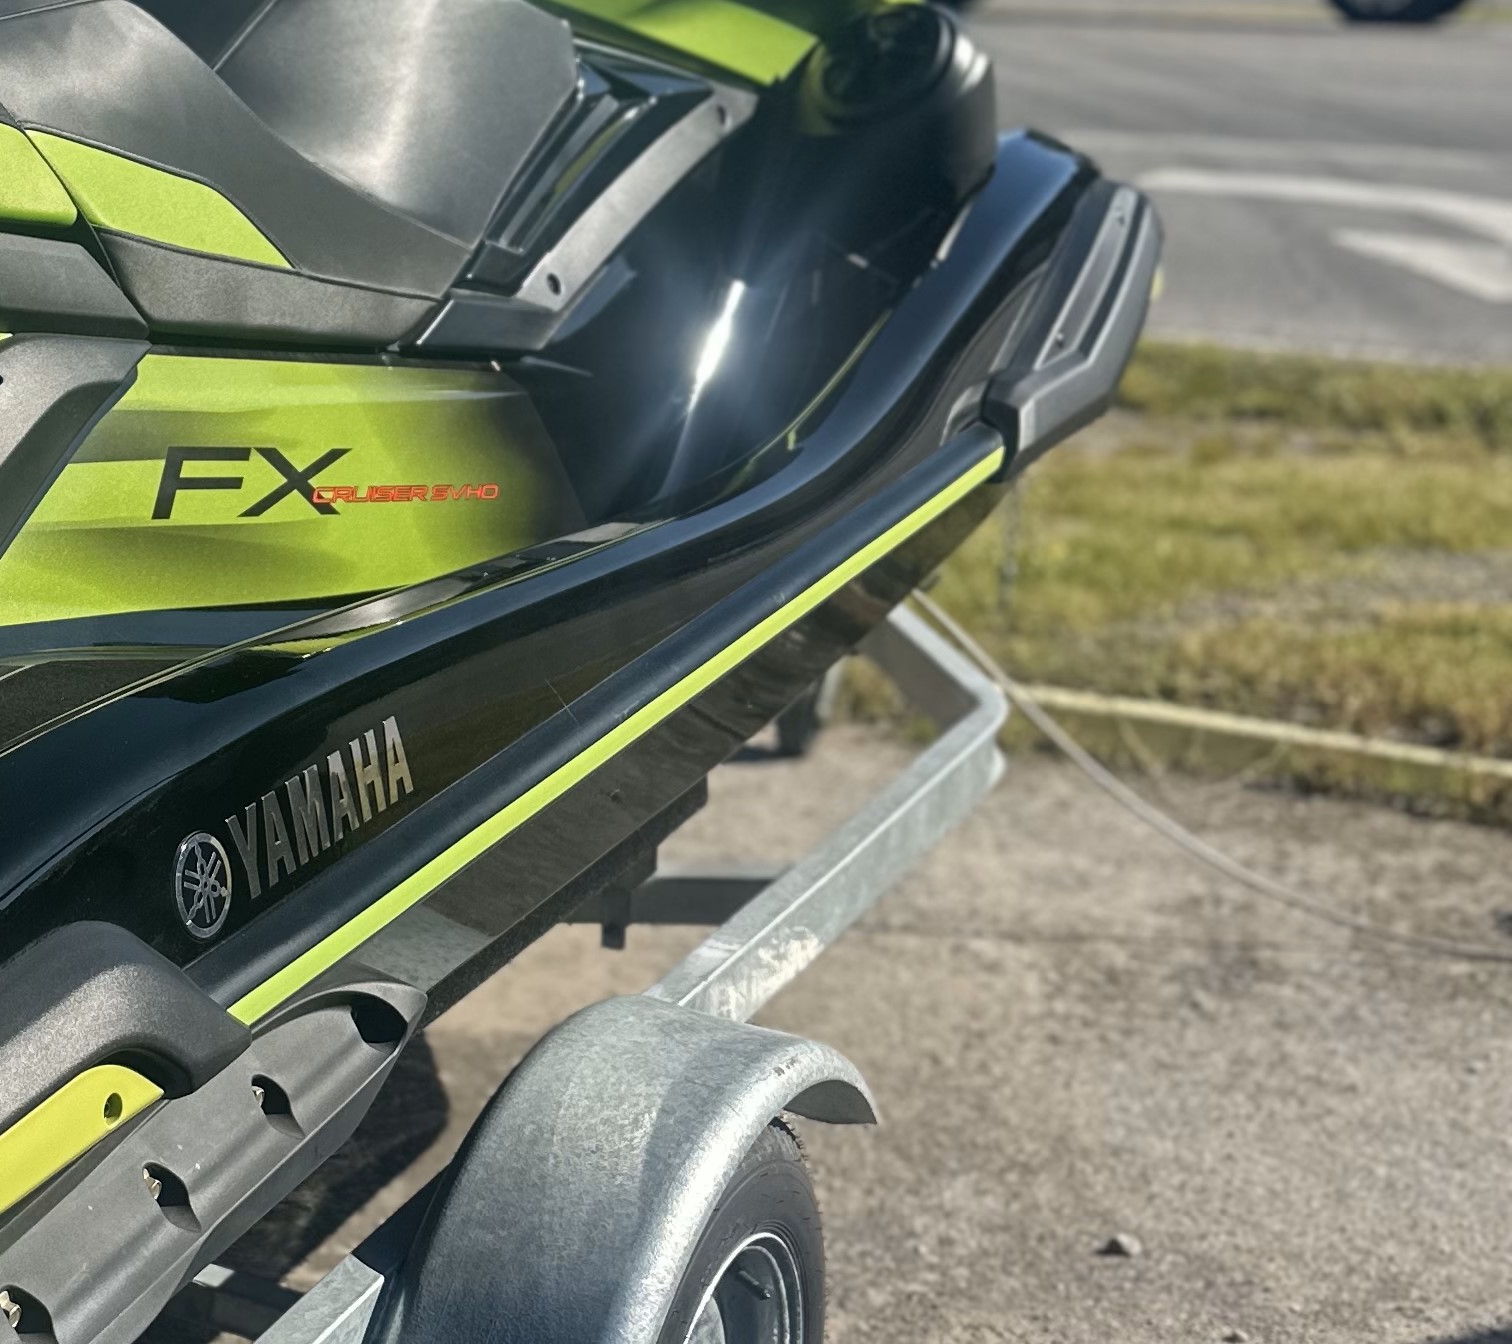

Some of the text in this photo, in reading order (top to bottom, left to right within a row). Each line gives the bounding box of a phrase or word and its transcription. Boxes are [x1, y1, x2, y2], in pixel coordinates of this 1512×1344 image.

[152, 446, 500, 520] FX CRUISER SVHO
[225, 716, 414, 899] YAMAHA
